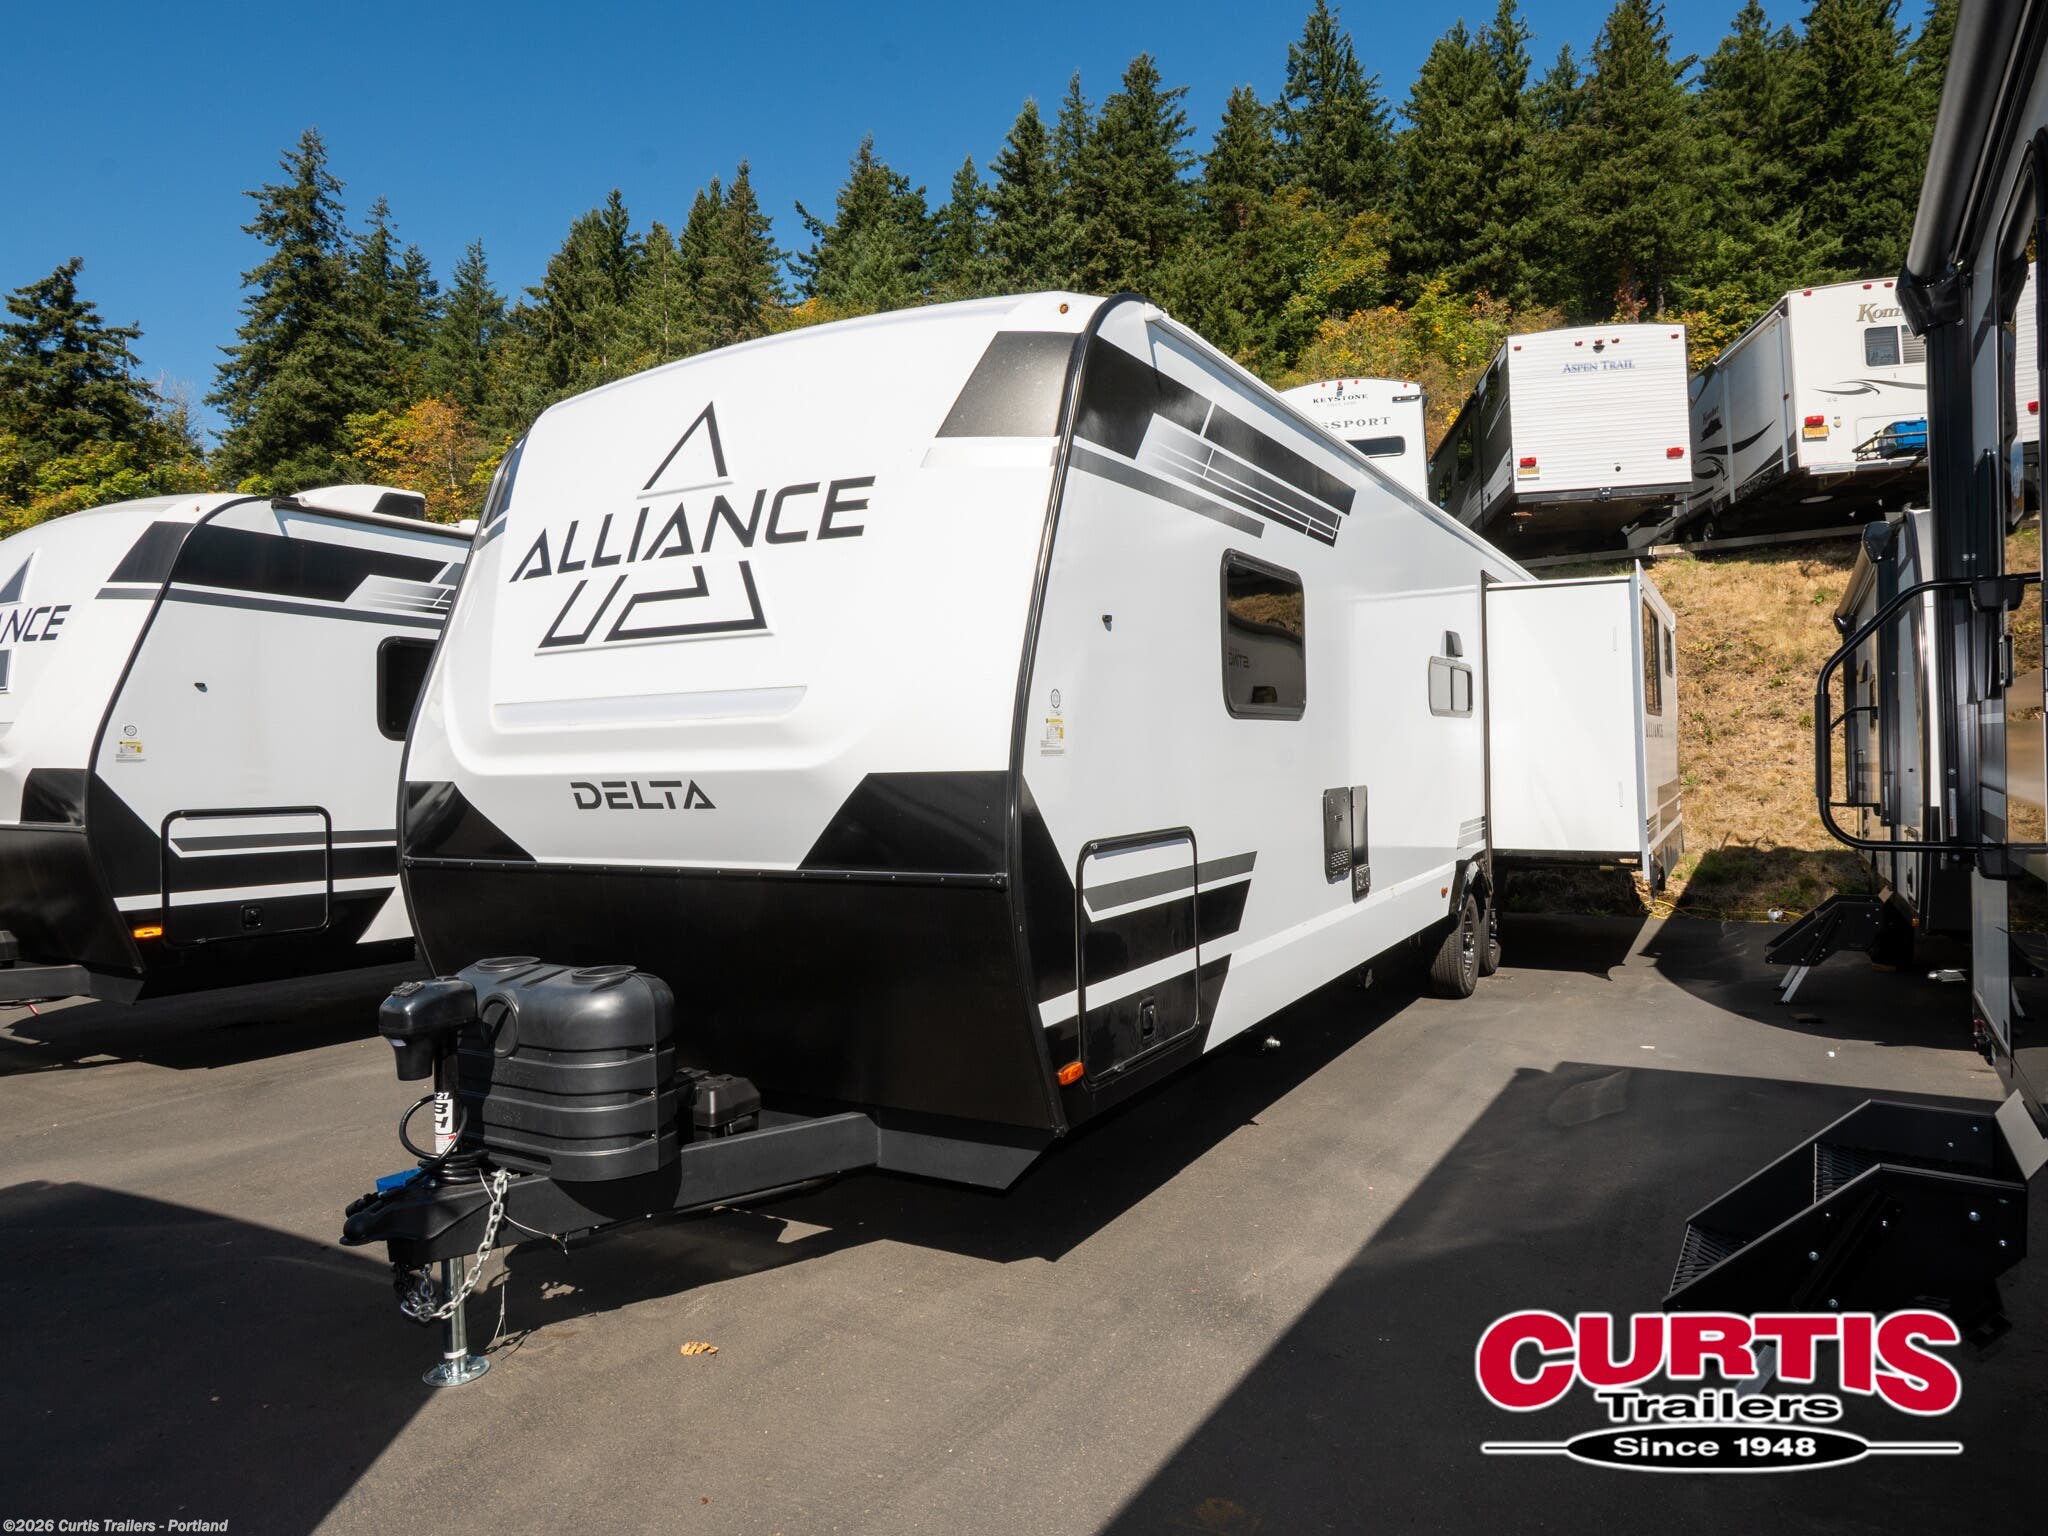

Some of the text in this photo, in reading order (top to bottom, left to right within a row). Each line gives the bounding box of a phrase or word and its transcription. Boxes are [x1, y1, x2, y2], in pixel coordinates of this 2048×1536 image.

[1856, 303, 1903, 323] Kom
[1562, 359, 1635, 374] ASPEN TRAIL
[1313, 393, 1368, 404] KEYSTONE
[1321, 416, 1391, 430] SSPORT
[509, 476, 876, 583] ALLIANCE
[0, 605, 72, 644] NCE
[570, 779, 717, 809] DELTA
